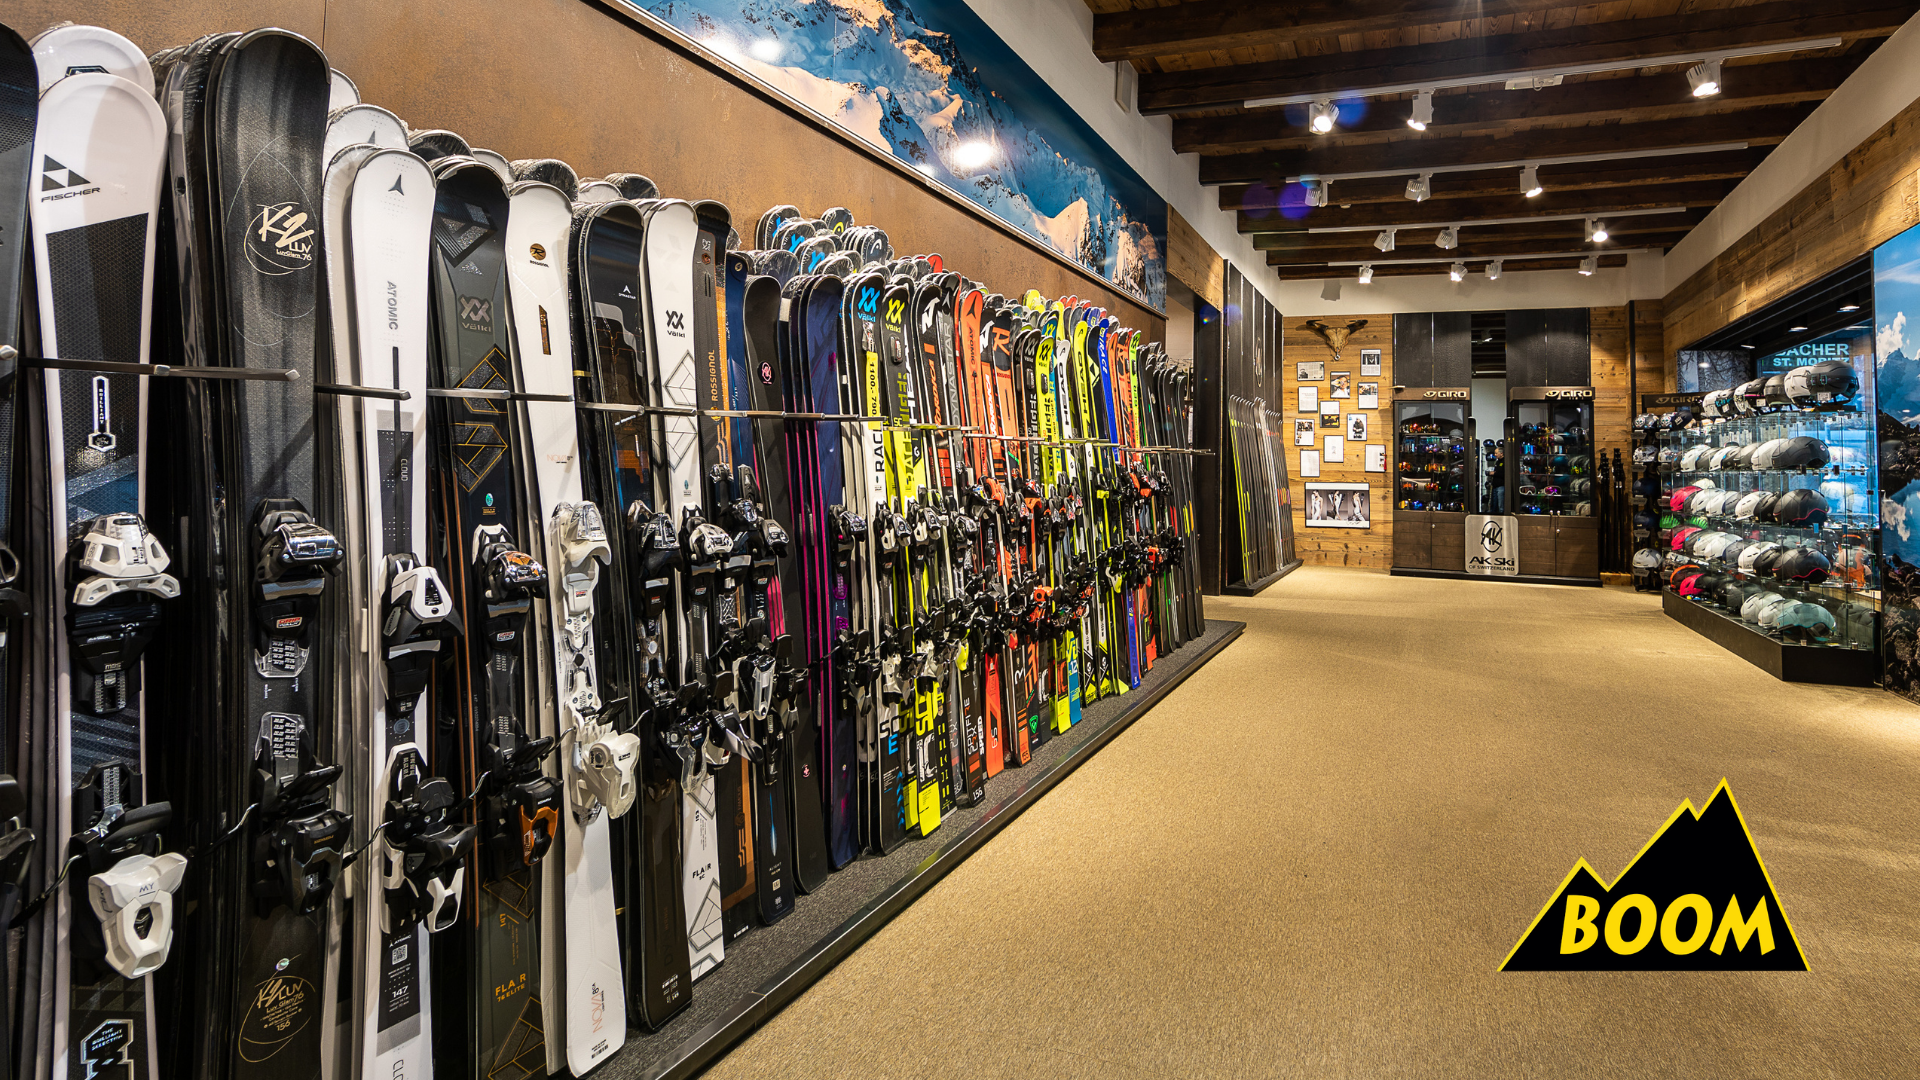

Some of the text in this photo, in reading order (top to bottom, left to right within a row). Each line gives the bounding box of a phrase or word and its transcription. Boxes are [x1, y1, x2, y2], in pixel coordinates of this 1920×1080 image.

[41, 187, 101, 203] FISCHER
[258, 205, 315, 248] K2
[289, 241, 312, 253] LUV
[387, 280, 399, 331] ATOMIC
[857, 311, 876, 322] Völkl
[462, 321, 492, 333] Völkl
[667, 330, 686, 338] Völkl
[968, 326, 976, 366] ATOMIC
[1773, 357, 1792, 367] ST.
[708, 349, 719, 402] ROSSIGNOL
[1058, 361, 1070, 426] HEAD
[1561, 390, 1593, 398] GIRO
[1469, 556, 1514, 566] AK Ski
[1477, 564, 1515, 572] SWITZERLAND
[139, 882, 155, 893] MY
[279, 980, 303, 1000] LUV
[495, 973, 526, 996] FLAR
[392, 985, 409, 998] 147
[591, 992, 603, 1033] NOVA
